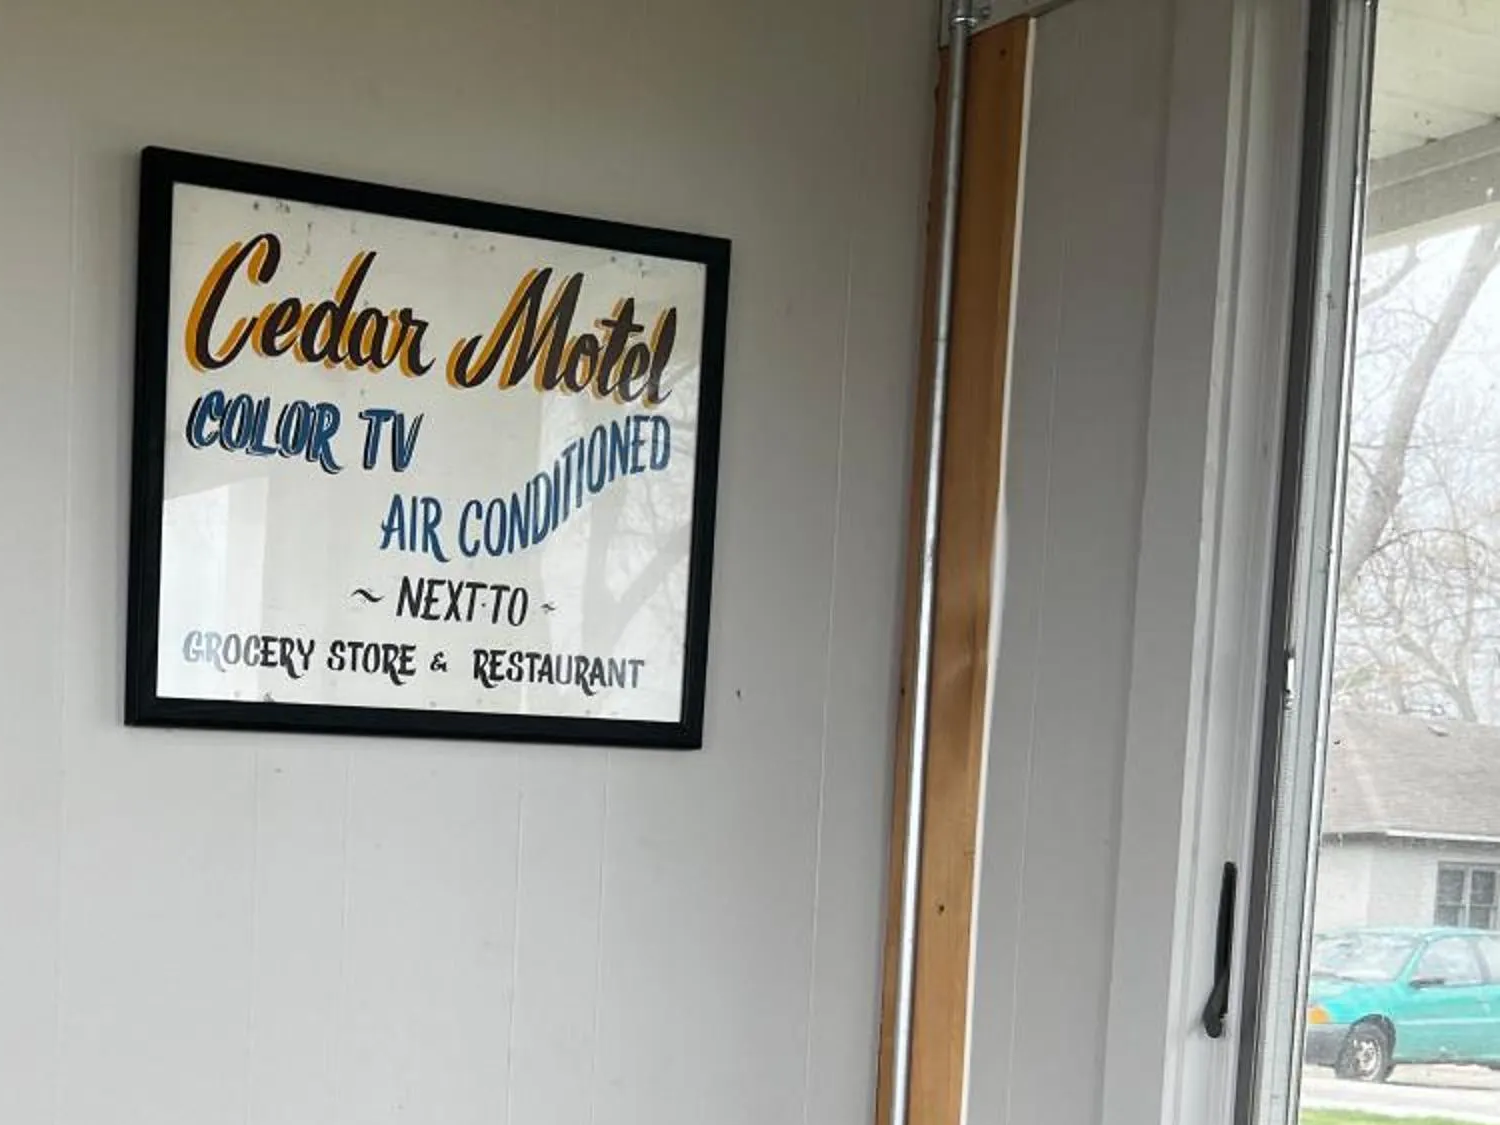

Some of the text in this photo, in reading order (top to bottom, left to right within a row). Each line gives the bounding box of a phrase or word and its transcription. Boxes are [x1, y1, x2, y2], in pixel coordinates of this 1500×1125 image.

[185, 233, 677, 407] Cedar Motel
[186, 390, 424, 474] COLOR TV
[380, 415, 671, 563] AIR CONDITIONED
[183, 630, 645, 696] GROCERY STORE & RESTAURANT
